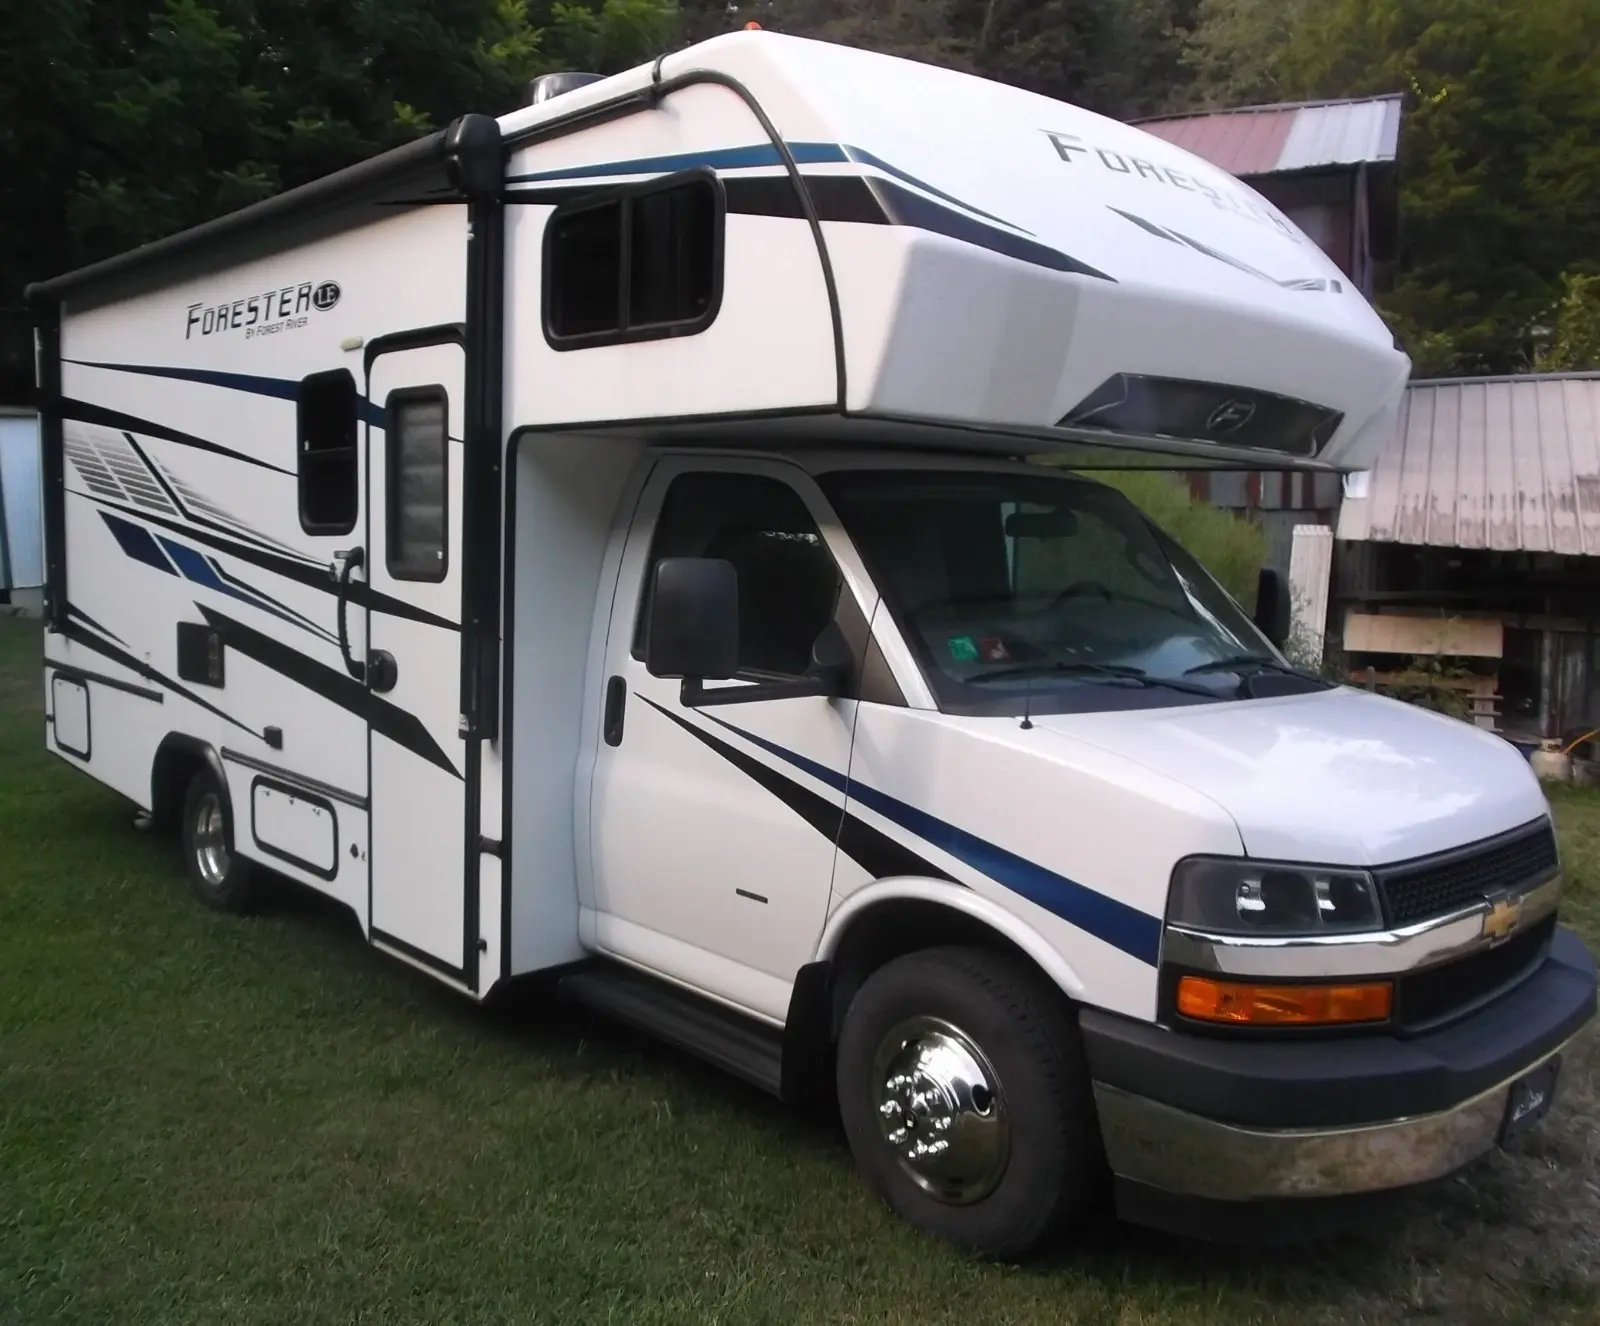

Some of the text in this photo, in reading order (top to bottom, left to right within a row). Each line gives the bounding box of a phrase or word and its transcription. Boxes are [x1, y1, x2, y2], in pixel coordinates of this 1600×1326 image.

[185, 281, 339, 340] FORESTER LE
[256, 320, 285, 337] FOREST
[285, 316, 308, 331] RIVER
